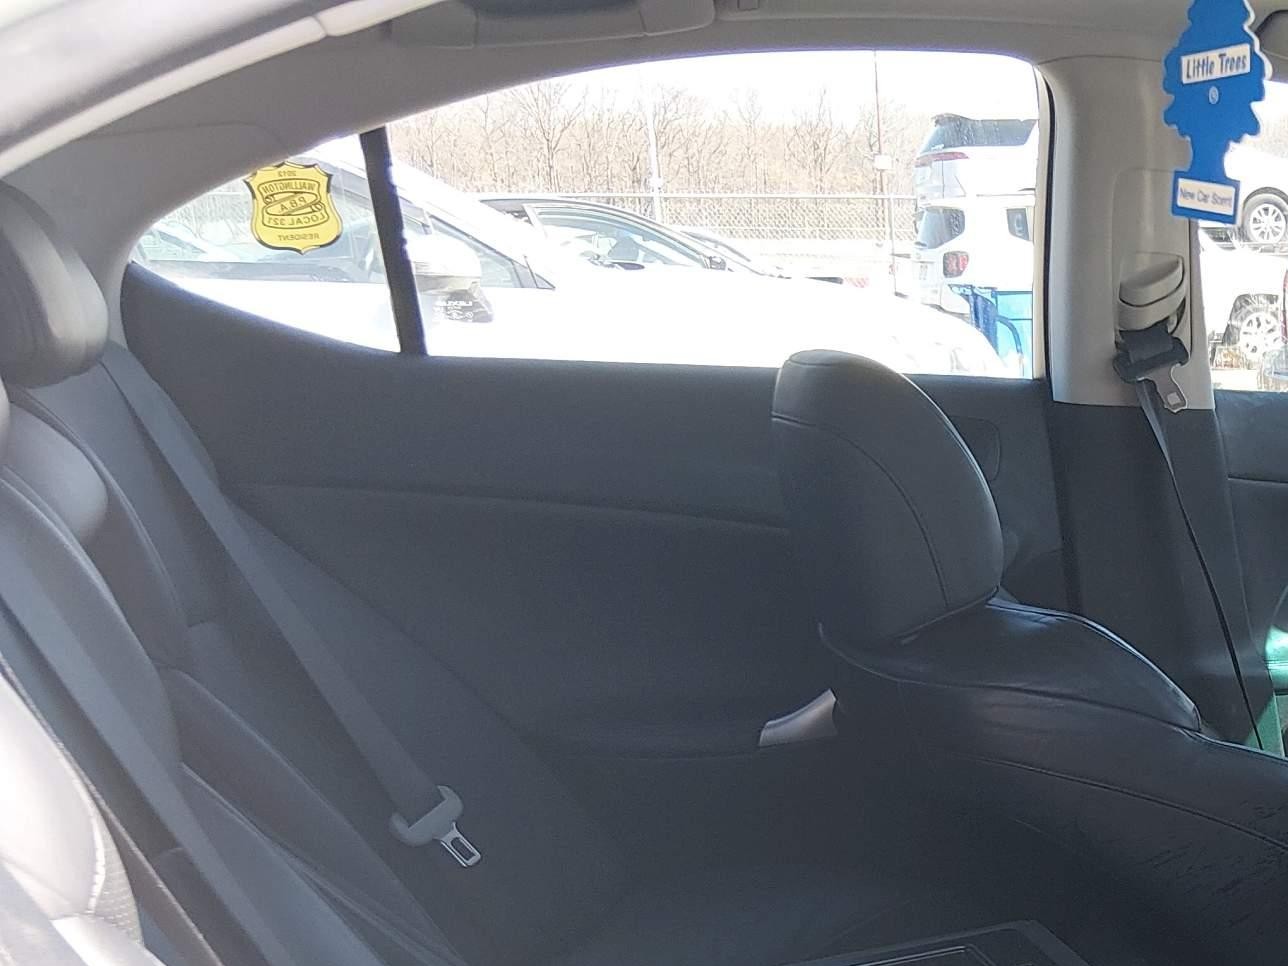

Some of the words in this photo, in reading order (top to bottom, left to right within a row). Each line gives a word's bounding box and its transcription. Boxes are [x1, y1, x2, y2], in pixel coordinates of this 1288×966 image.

[1186, 55, 1215, 80] Little
[1218, 52, 1247, 74] Trees
[1180, 187, 1195, 200] New
[1197, 189, 1210, 203] Car
[1211, 192, 1233, 208] Scent
